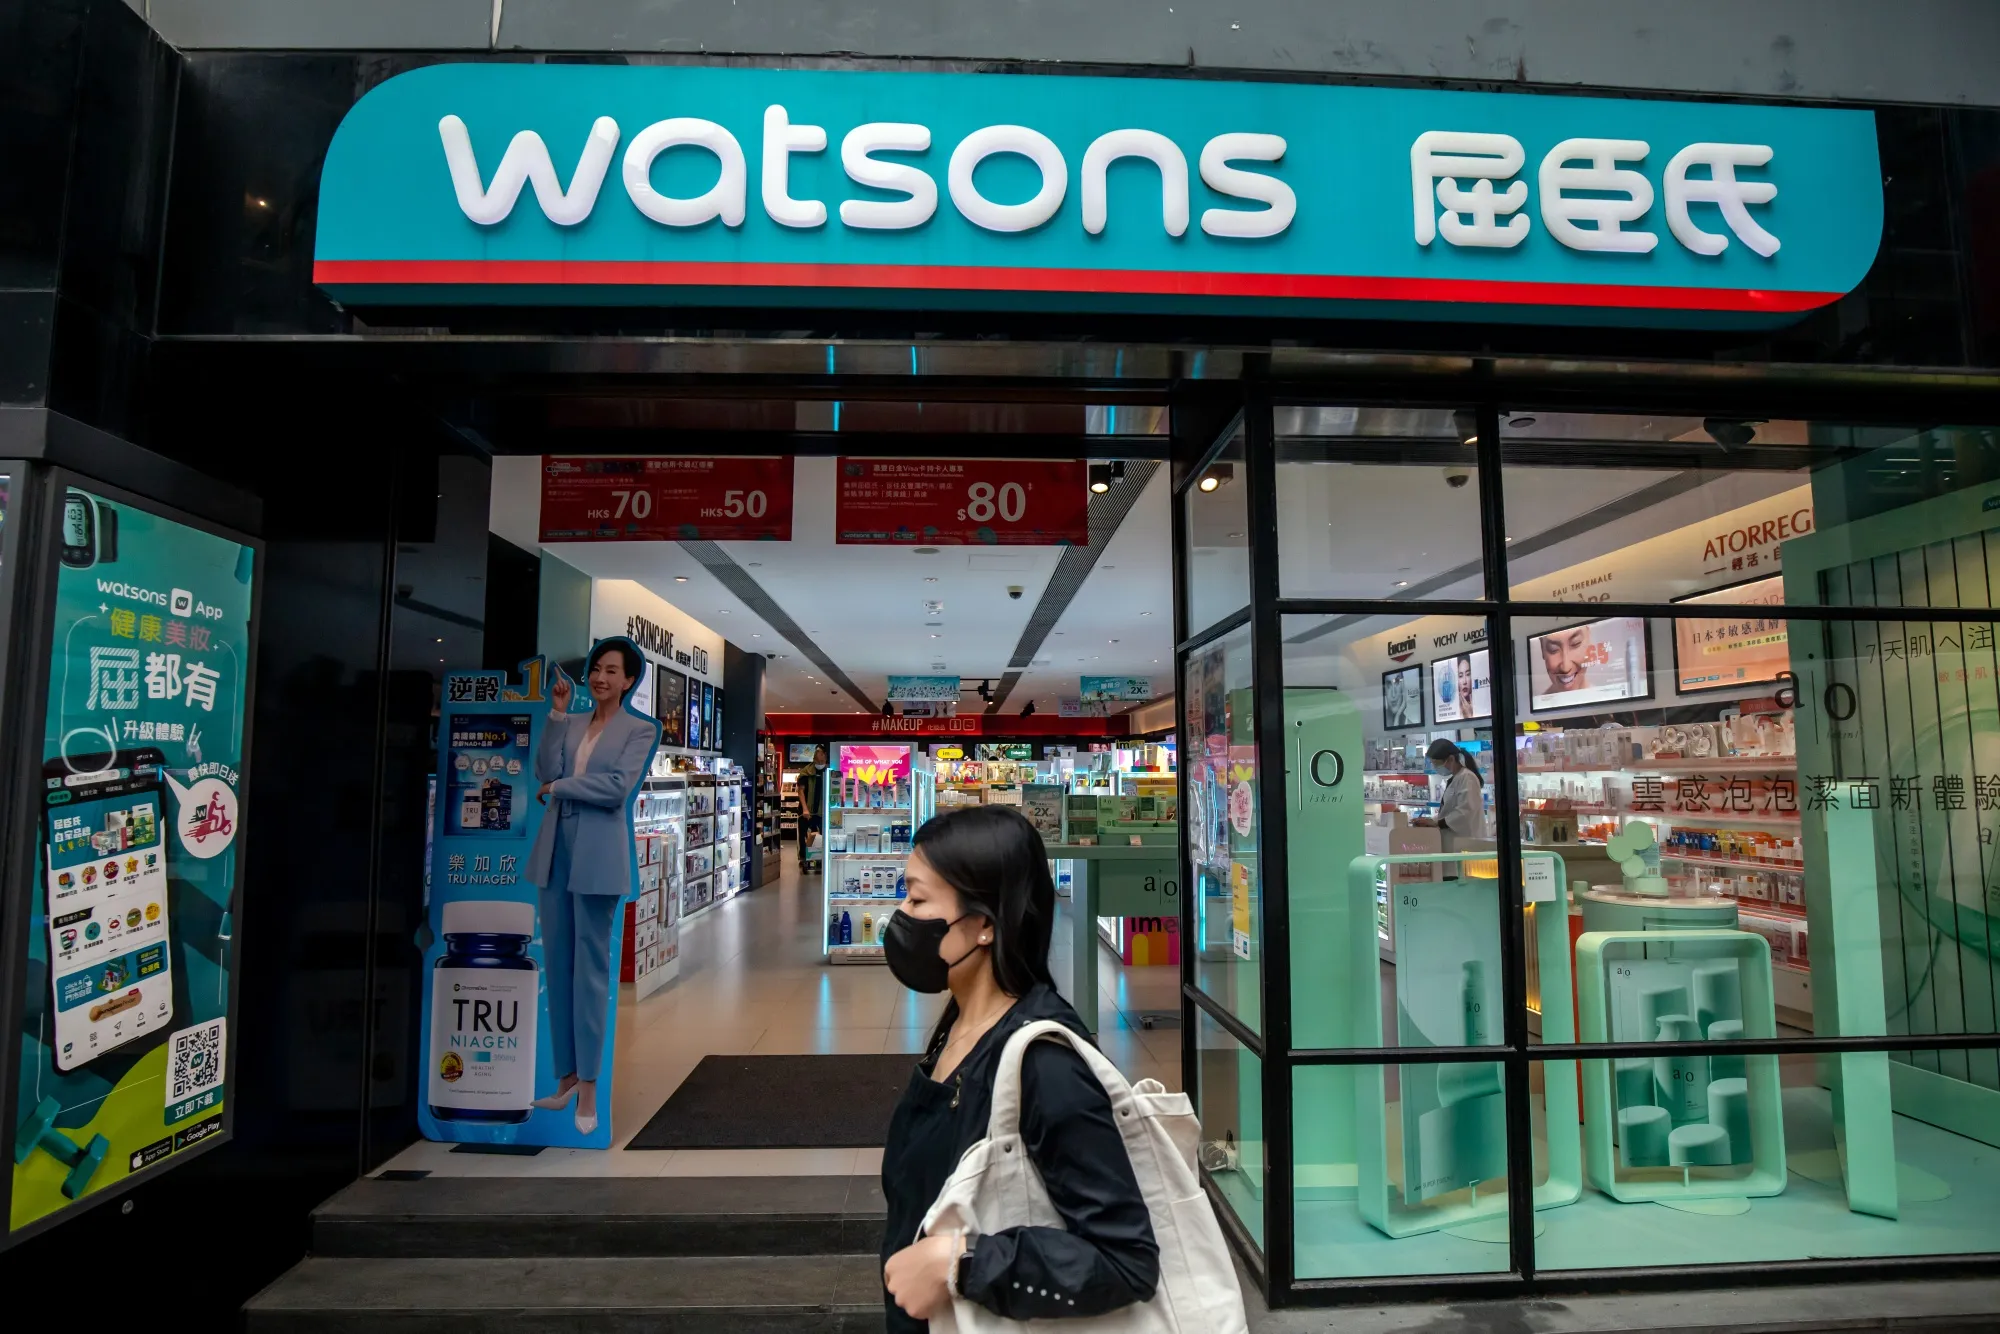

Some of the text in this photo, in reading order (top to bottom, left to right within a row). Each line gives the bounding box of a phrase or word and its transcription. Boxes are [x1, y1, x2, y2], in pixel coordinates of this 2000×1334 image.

[438, 103, 1298, 240] watsons
[1410, 130, 1782, 258] 屈臣氏
[1703, 506, 1816, 562] ATORREG
[1552, 587, 1568, 598] EAU
[1571, 572, 1613, 591] THERMALE
[96, 577, 168, 607] watsons
[194, 601, 224, 620] App
[110, 606, 212, 652] 健康美妝
[1433, 631, 1458, 648] VICHY
[1387, 633, 1417, 656] Eucerin
[86, 646, 220, 712] 屈都有
[448, 676, 499, 703] 逆齡
[123, 719, 185, 742] 升級體驗
[187, 761, 240, 787] 最快即日送
[53, 815, 82, 830] 屈臣氏
[448, 873, 517, 886] TRU NIAGEN
[452, 999, 518, 1033] TRU
[450, 1034, 518, 1049] NIAGEN
[174, 1092, 214, 1120] 立即下載
[186, 1121, 220, 1142] Google Play
